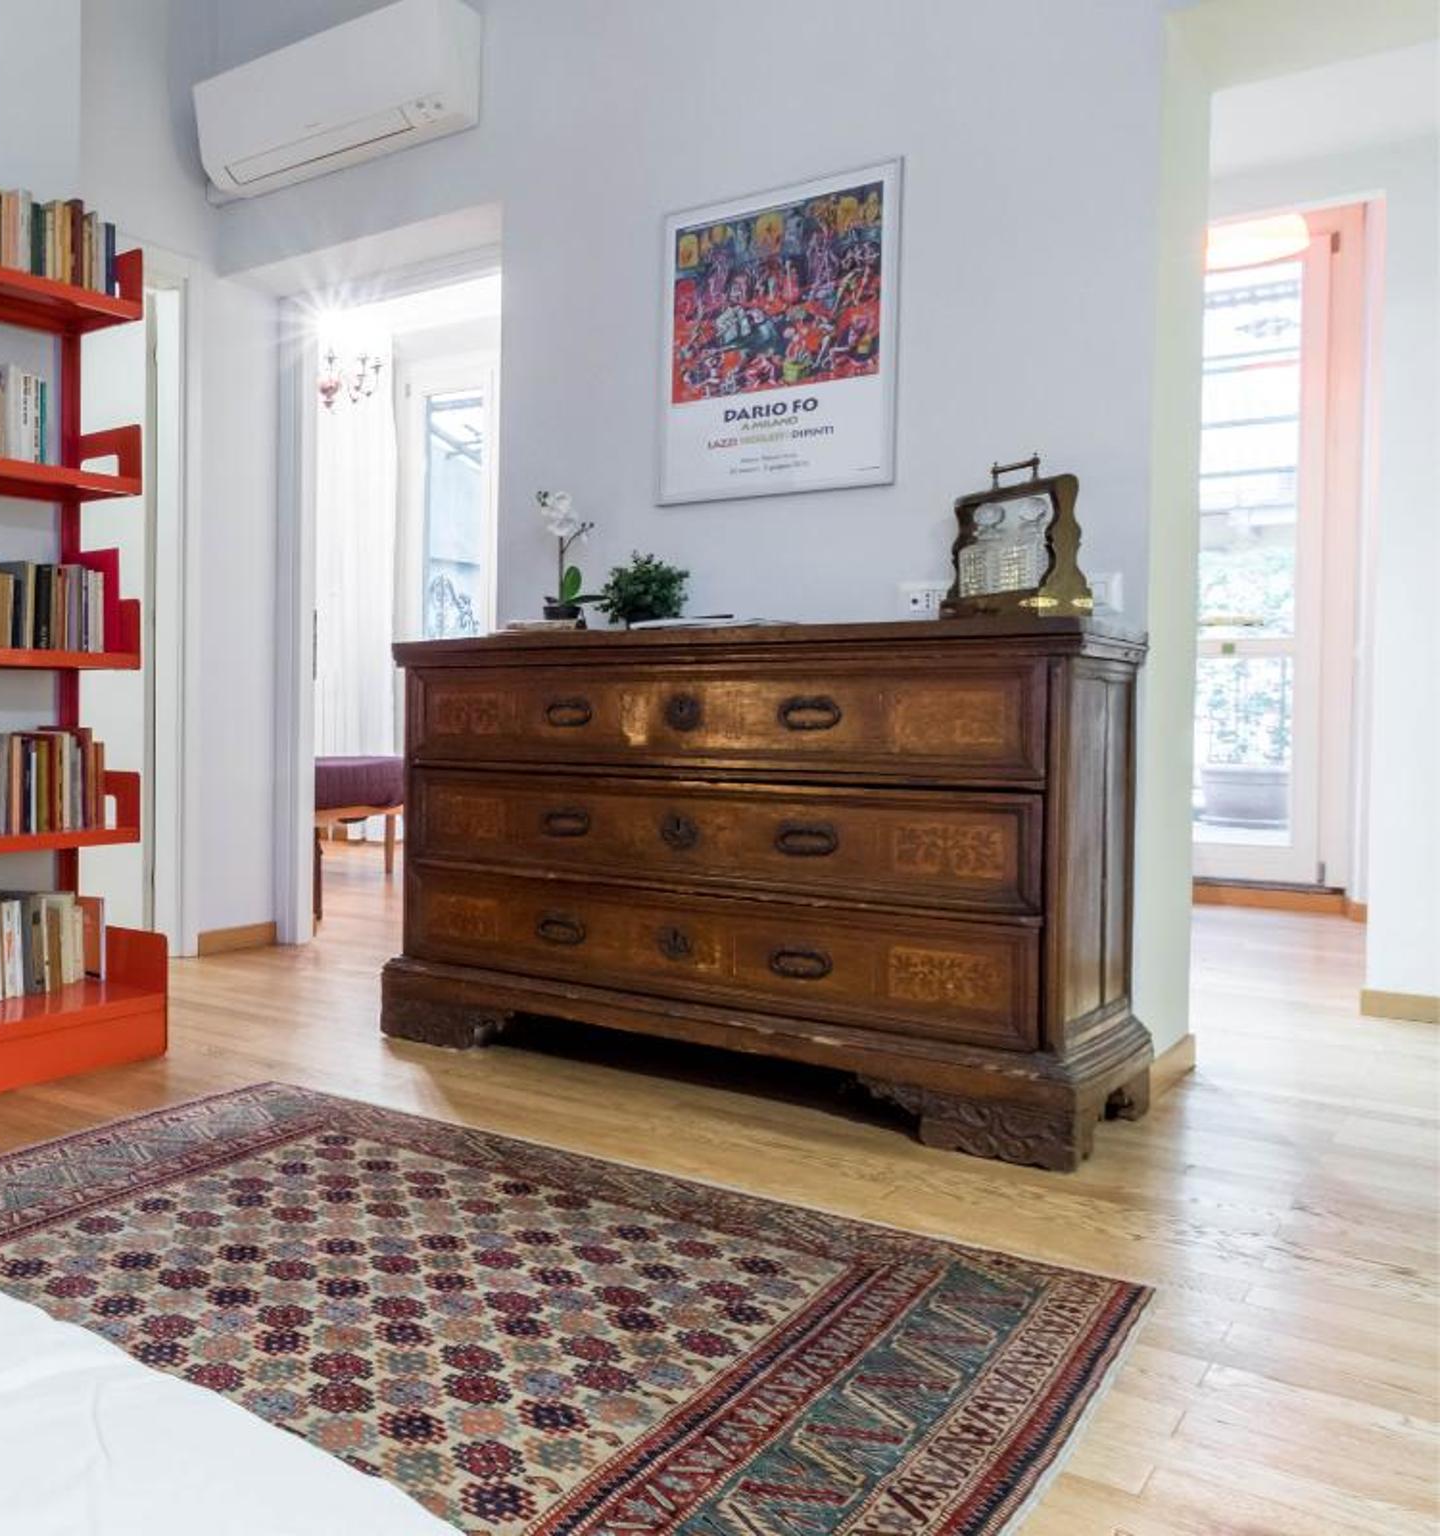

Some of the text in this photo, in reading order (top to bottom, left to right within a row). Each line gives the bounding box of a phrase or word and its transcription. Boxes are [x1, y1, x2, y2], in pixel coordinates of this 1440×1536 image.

[724, 398, 818, 423] DARIO FO
[751, 416, 798, 430] MILANO
[792, 426, 834, 439] DIPINTI
